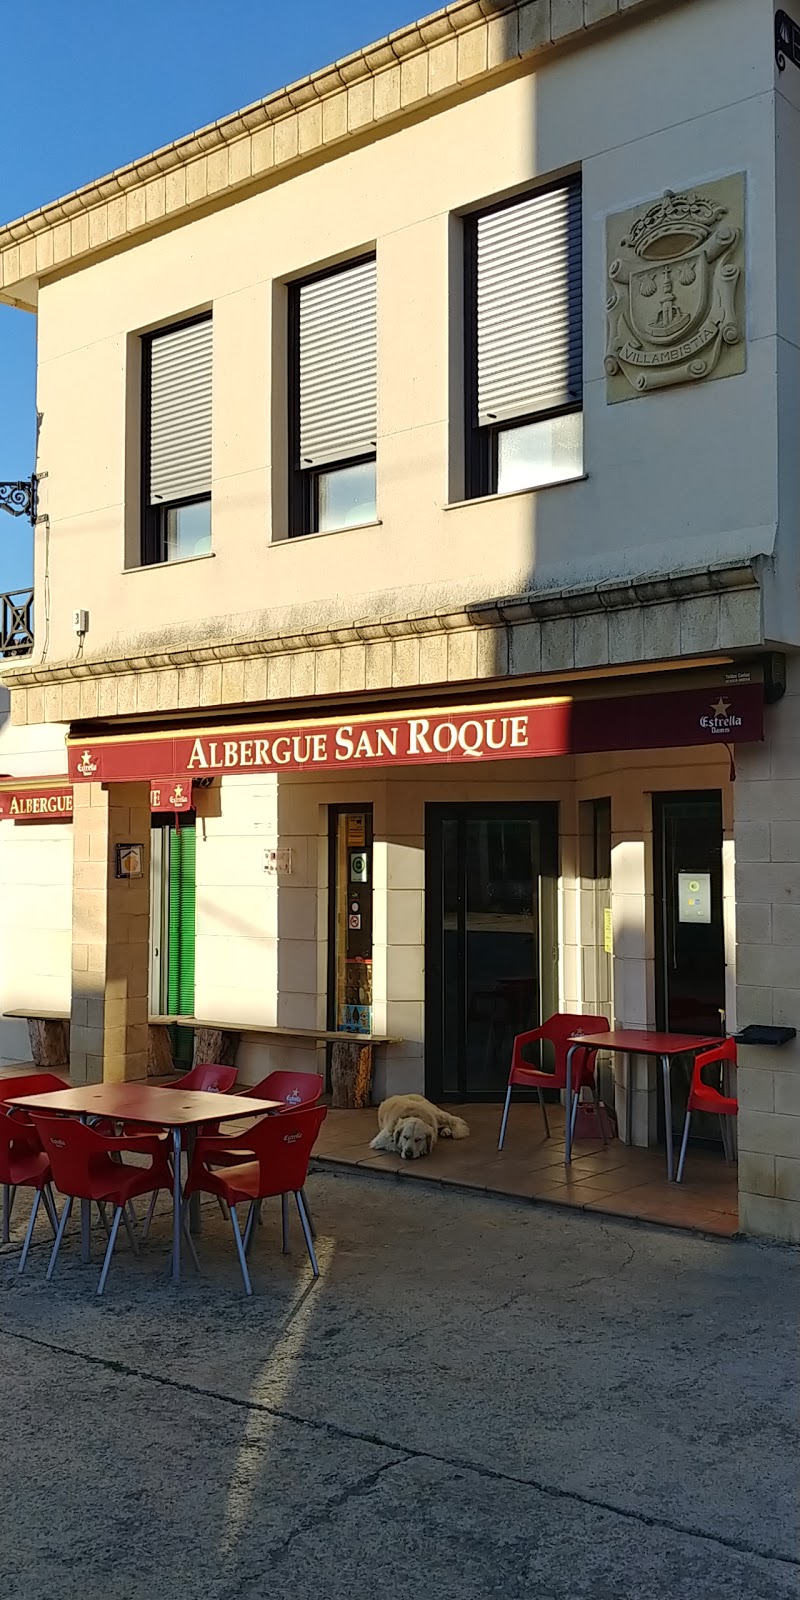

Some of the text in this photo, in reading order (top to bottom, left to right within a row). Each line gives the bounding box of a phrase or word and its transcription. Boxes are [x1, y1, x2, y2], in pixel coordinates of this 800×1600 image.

[624, 329, 714, 364] VILLAMBISTIA
[699, 715, 742, 728] Estrella
[186, 716, 529, 769] ALBERGUE SAN ROQUE
[9, 795, 73, 815] ALBERGUE
